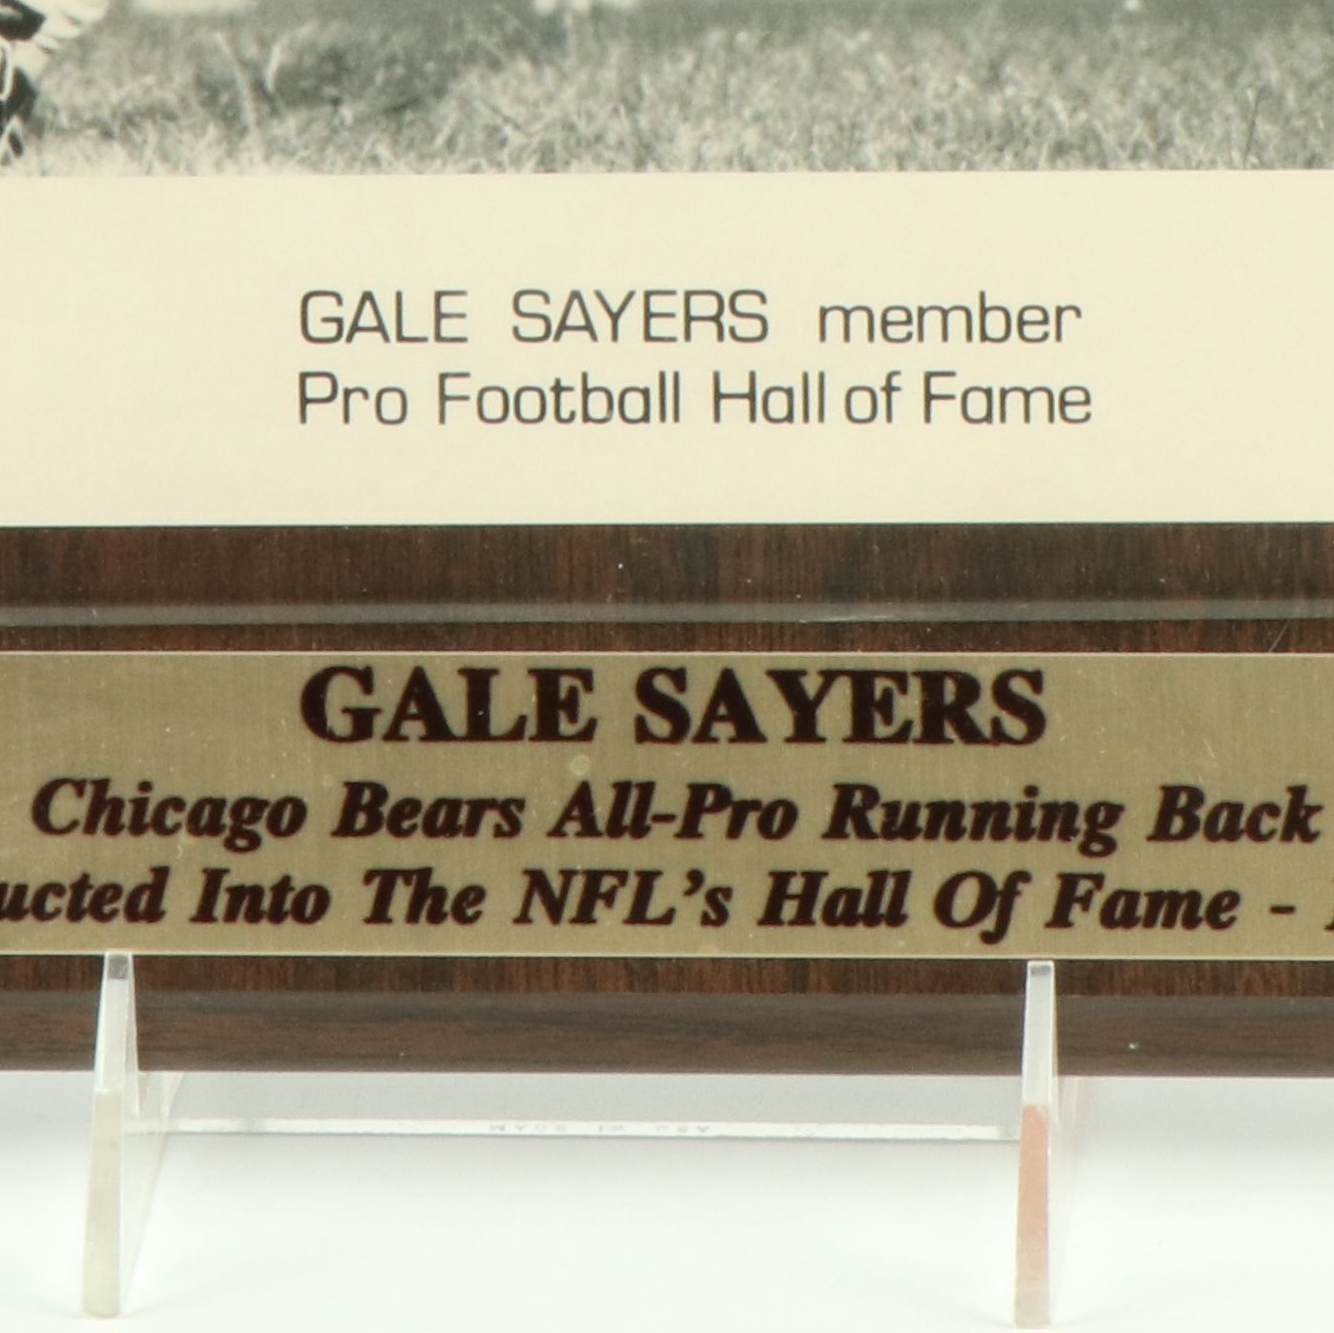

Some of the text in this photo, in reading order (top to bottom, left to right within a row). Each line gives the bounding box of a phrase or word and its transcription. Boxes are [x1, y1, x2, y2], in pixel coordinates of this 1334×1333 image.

[299, 288, 1083, 345] GALE SAYERS member
[298, 369, 1092, 426] Pro Football Hall of Fame
[298, 663, 1048, 748] GALE SAYERS
[30, 776, 1325, 859] Chicago Bears All-Pro Running Back
[188, 866, 333, 927] Into
[361, 865, 488, 927] The
[511, 867, 735, 929] NFL's
[755, 867, 914, 930] Hall
[932, 868, 1036, 947] Of
[1041, 870, 1242, 932] Fame
